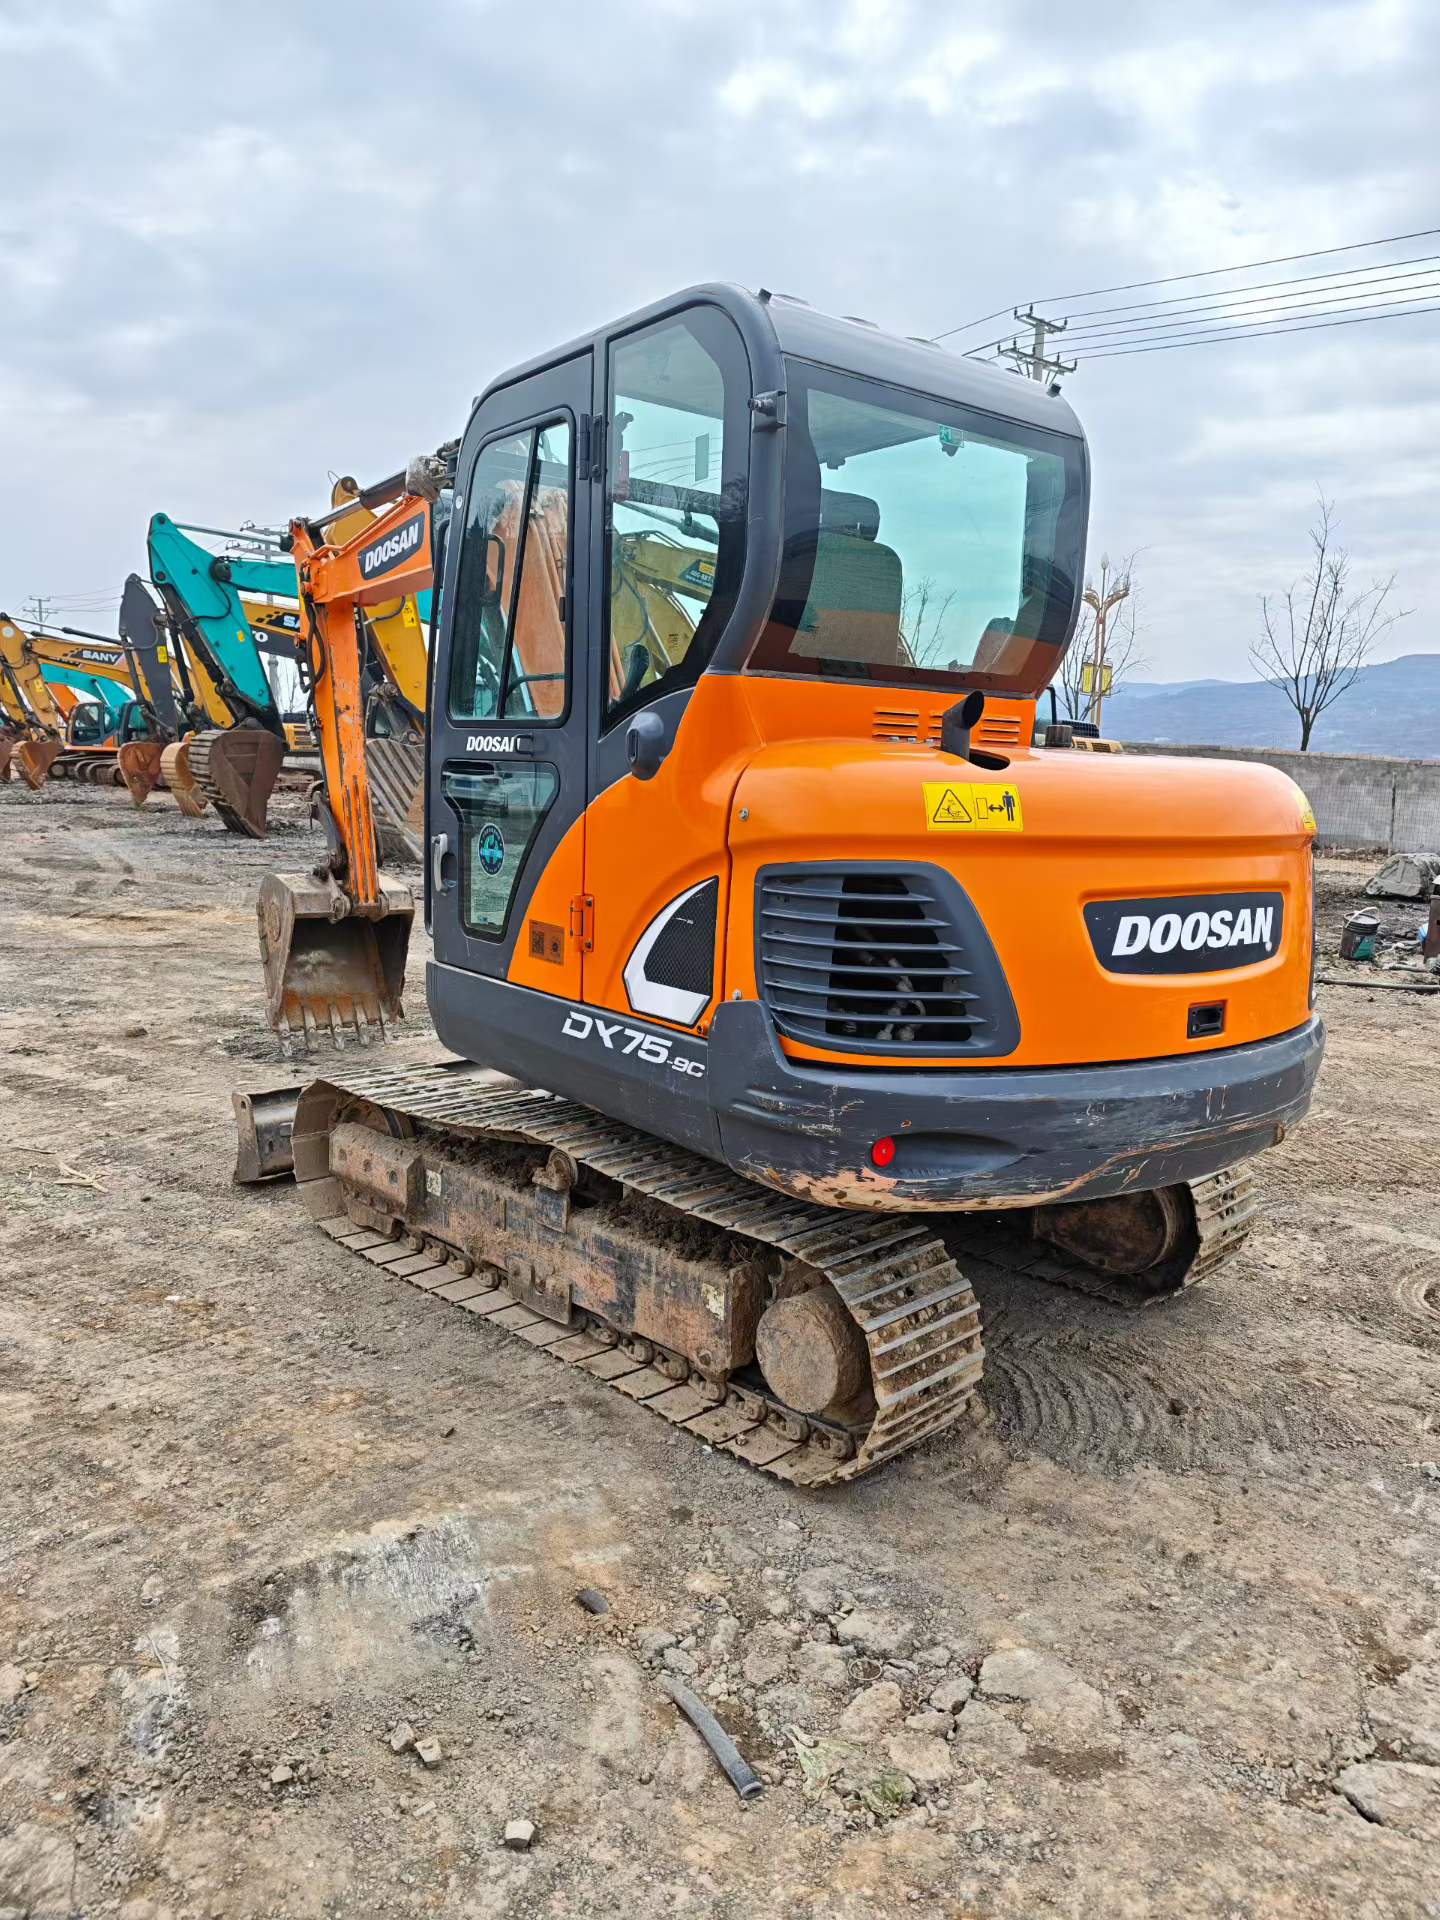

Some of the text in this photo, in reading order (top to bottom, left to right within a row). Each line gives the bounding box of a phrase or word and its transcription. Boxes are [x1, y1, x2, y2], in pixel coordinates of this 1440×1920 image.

[365, 522, 419, 573] DOOSAN
[82, 650, 118, 662] SANY
[1111, 907, 1273, 956] DOOSAN
